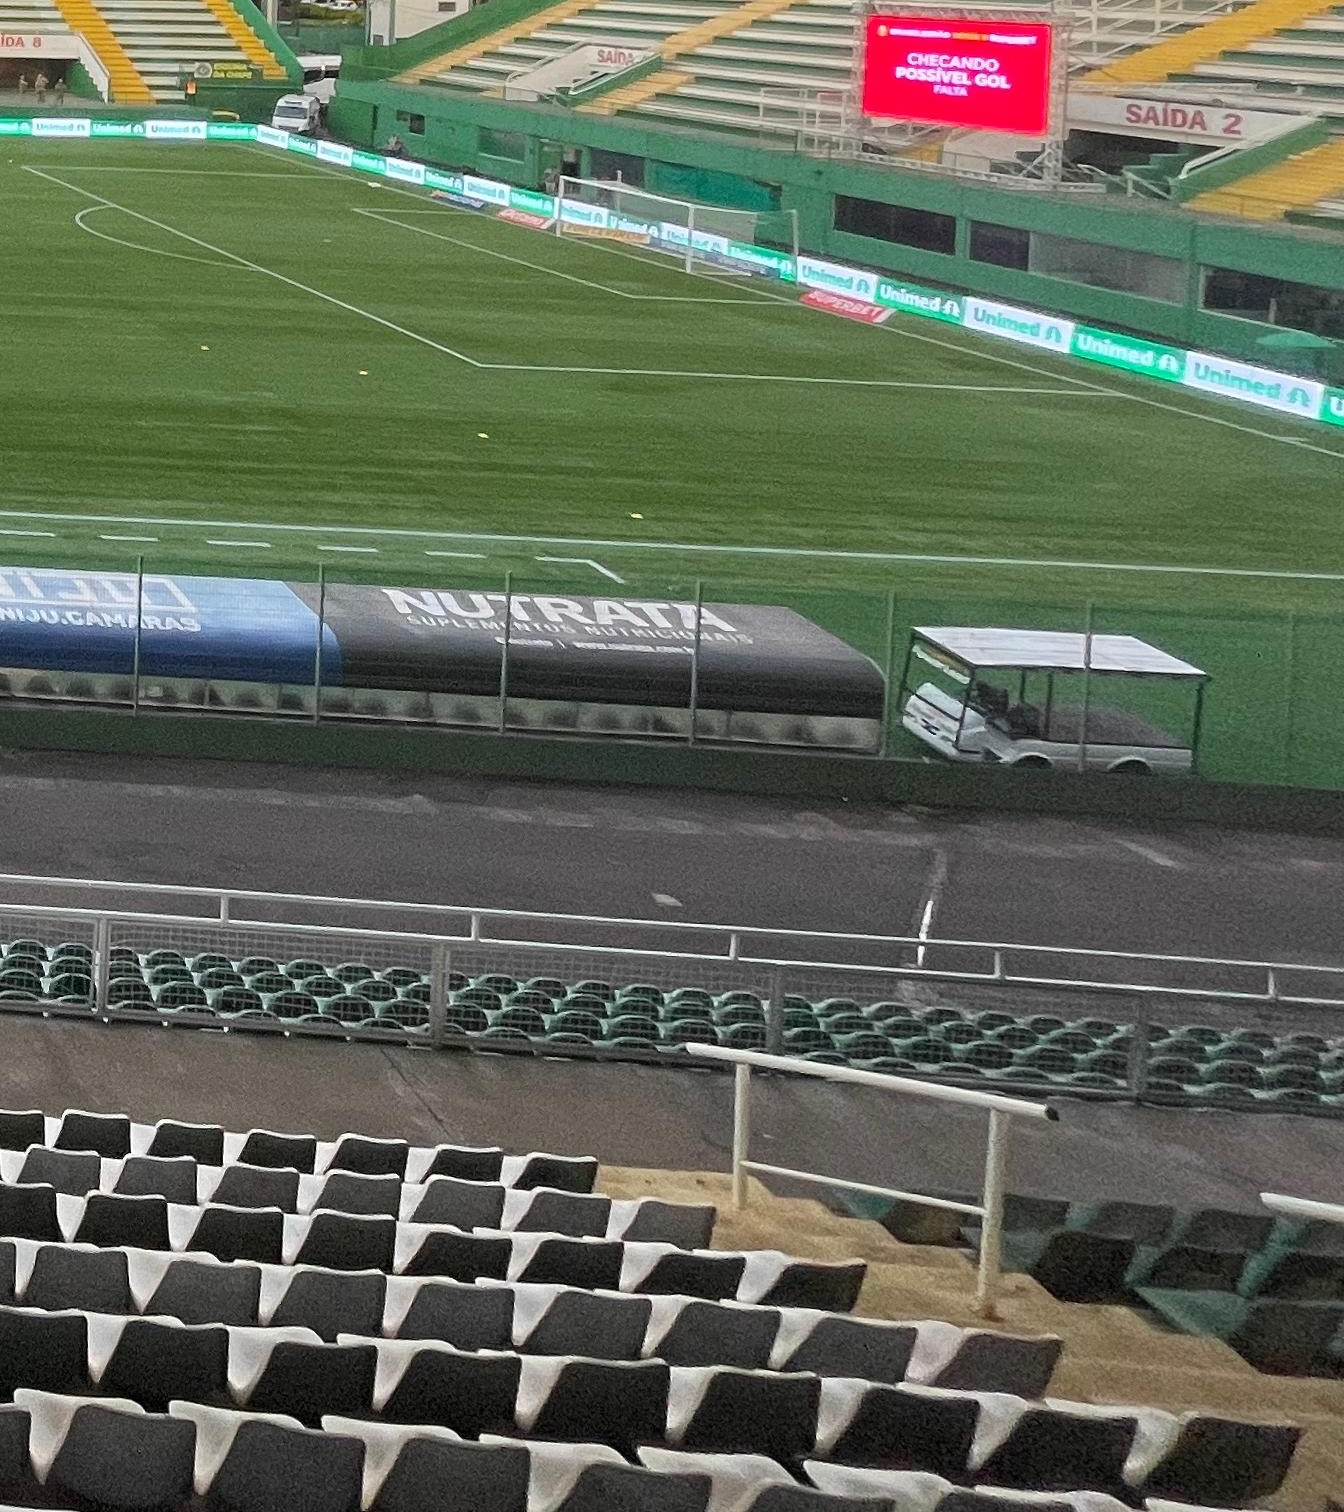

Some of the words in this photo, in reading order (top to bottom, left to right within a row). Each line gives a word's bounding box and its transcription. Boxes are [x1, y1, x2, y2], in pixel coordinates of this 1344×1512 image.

[32, 37, 41, 47] 8
[907, 53, 999, 72] CHECANDO
[896, 66, 972, 85] POSSÍVEL
[975, 74, 1011, 89] GOL
[934, 85, 968, 96] FALTA
[1125, 101, 1207, 131] SAÍDA
[1223, 114, 1243, 135] 2
[802, 266, 853, 288] Unimed
[881, 285, 941, 310] Unimed
[974, 308, 1040, 336] Unimed
[1078, 334, 1153, 366] Unimed
[1195, 363, 1280, 397] Unimed
[382, 589, 737, 632] NUTRATA
